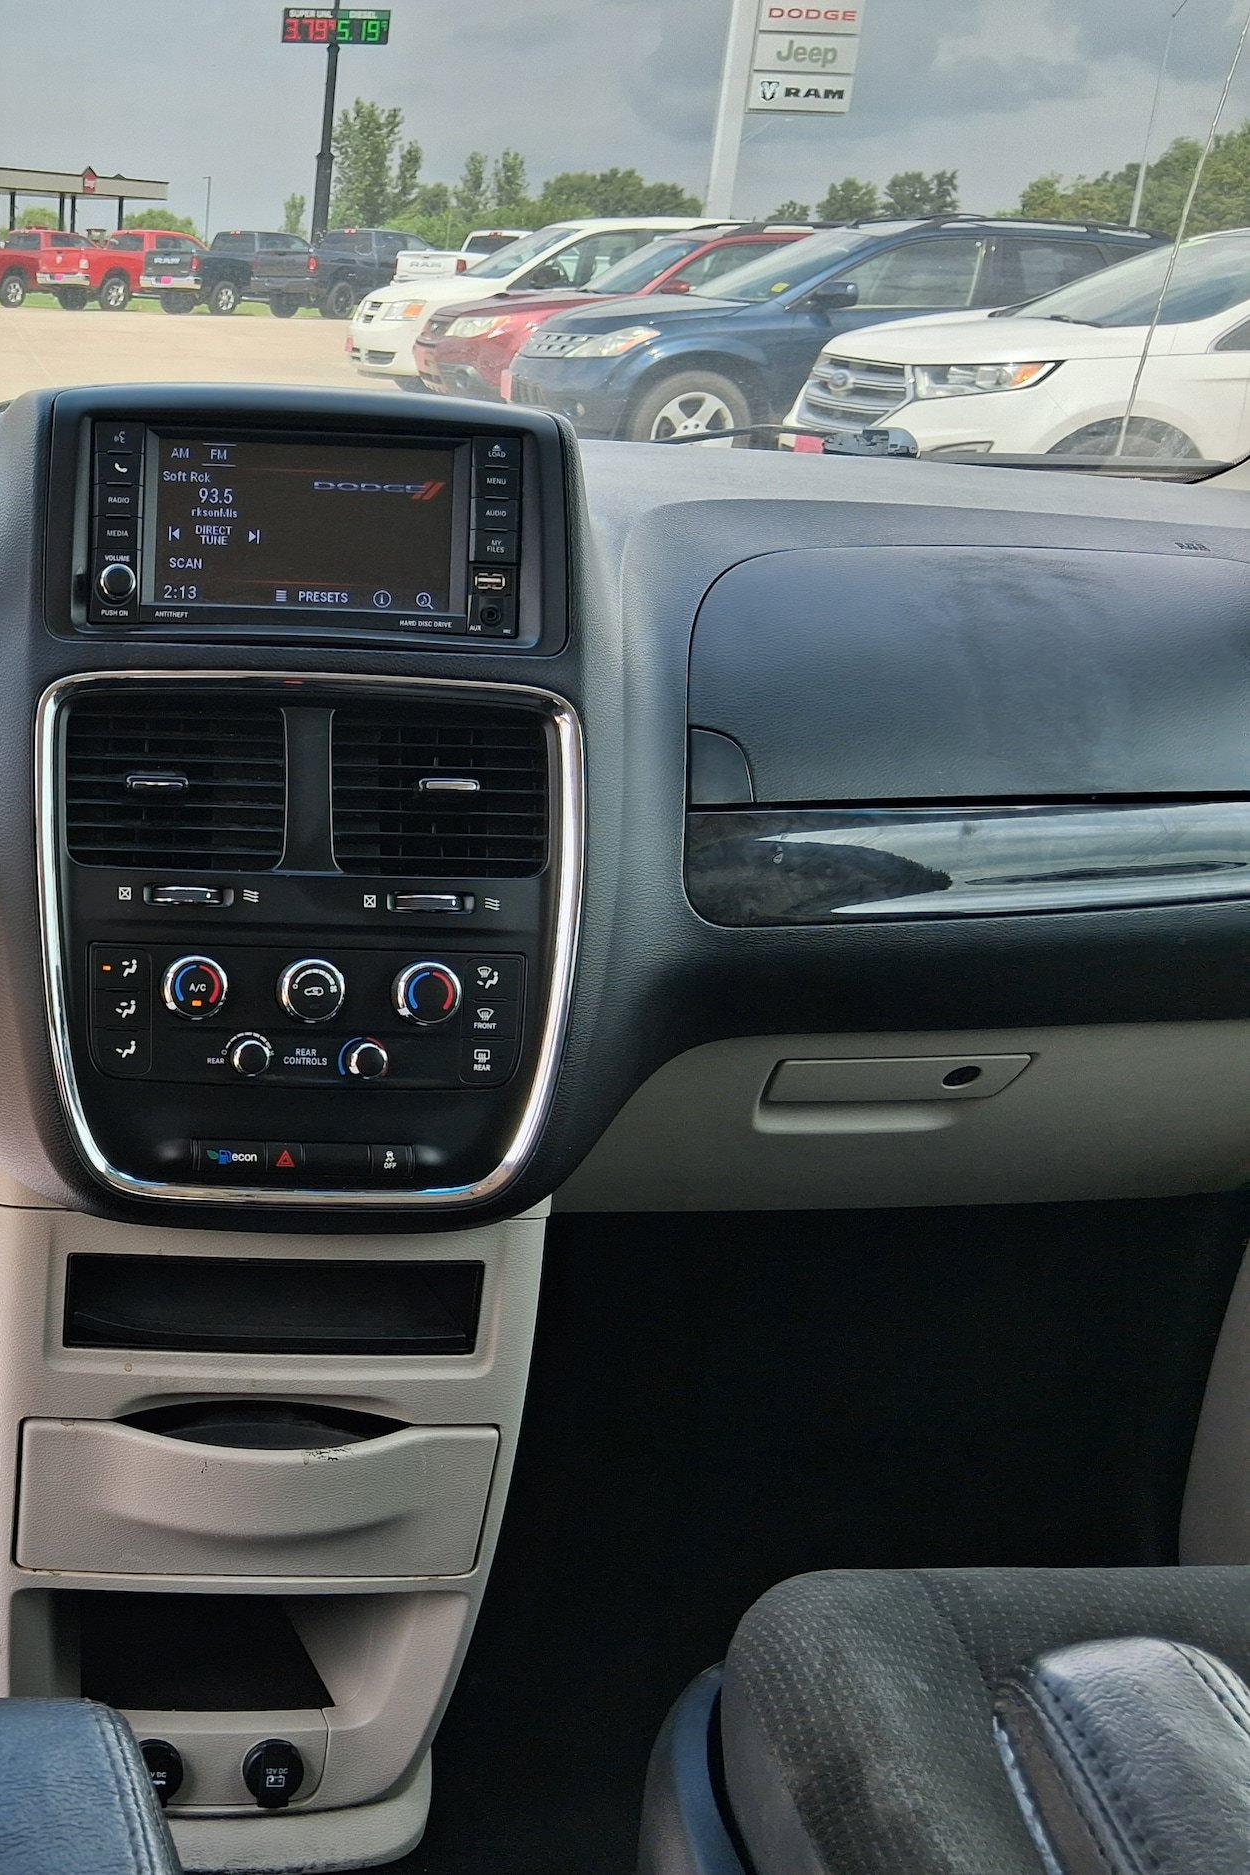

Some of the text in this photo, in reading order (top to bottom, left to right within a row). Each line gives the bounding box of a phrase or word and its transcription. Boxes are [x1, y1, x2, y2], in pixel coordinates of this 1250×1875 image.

[768, 8, 857, 21] DODGE
[776, 40, 838, 68] Jeep
[784, 87, 845, 99] RAM
[409, 260, 442, 268] RAM
[171, 447, 190, 459] AM
[210, 449, 228, 460] FM
[162, 471, 211, 483] Soft Rck
[313, 481, 427, 494] DODGE
[199, 487, 233, 504] 93.5
[195, 525, 233, 536] DIRECT
[200, 535, 228, 546] TUNE
[104, 554, 130, 562] VOLUME
[169, 557, 203, 569] SCAN
[163, 585, 197, 599] 2:13
[299, 590, 349, 604] PRESETS
[101, 609, 118, 617] PUSH
[154, 611, 189, 619] ANTITHEFT
[399, 619, 452, 629] HARD DISC DRIVE
[189, 982, 207, 992] A/C
[473, 1022, 497, 1030] FRONT
[295, 1048, 317, 1057] REAR
[207, 1057, 225, 1065] REAR
[283, 1056, 328, 1066] CONTROLS
[473, 1063, 491, 1072] REAR
[231, 1151, 258, 1162] econ
[383, 1162, 398, 1170] OFF
